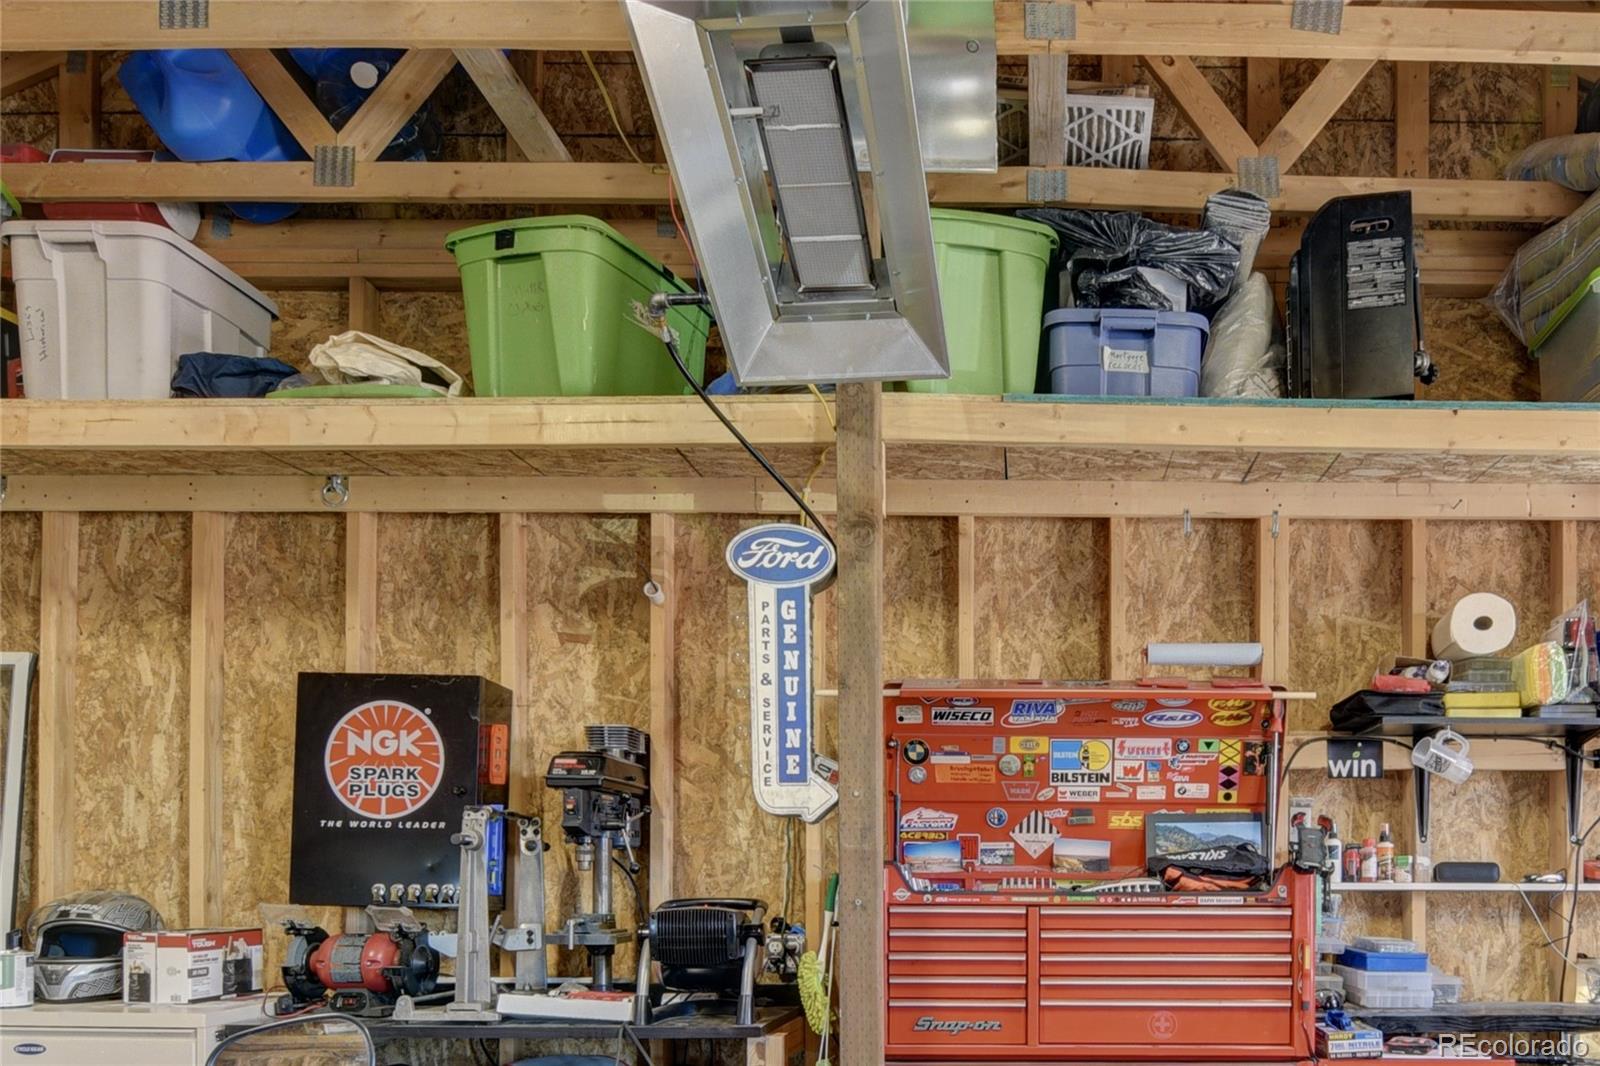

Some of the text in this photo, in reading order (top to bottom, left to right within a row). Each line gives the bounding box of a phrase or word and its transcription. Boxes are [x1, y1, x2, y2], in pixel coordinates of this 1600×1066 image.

[737, 537, 825, 569] Ford
[760, 601, 772, 787] PARTS & SERVICE
[780, 600, 801, 775] GENUINE
[933, 711, 992, 721] WISECO
[1013, 700, 1057, 715] RIVA
[347, 729, 422, 757] NGK
[1328, 751, 1377, 777] win
[349, 766, 420, 781] SPARK
[1051, 772, 1110, 783] BILSTEIN
[349, 783, 420, 798] PLUGS
[320, 820, 447, 830] THE WORLD LEADER
[913, 1016, 1002, 1036] Snap-on
